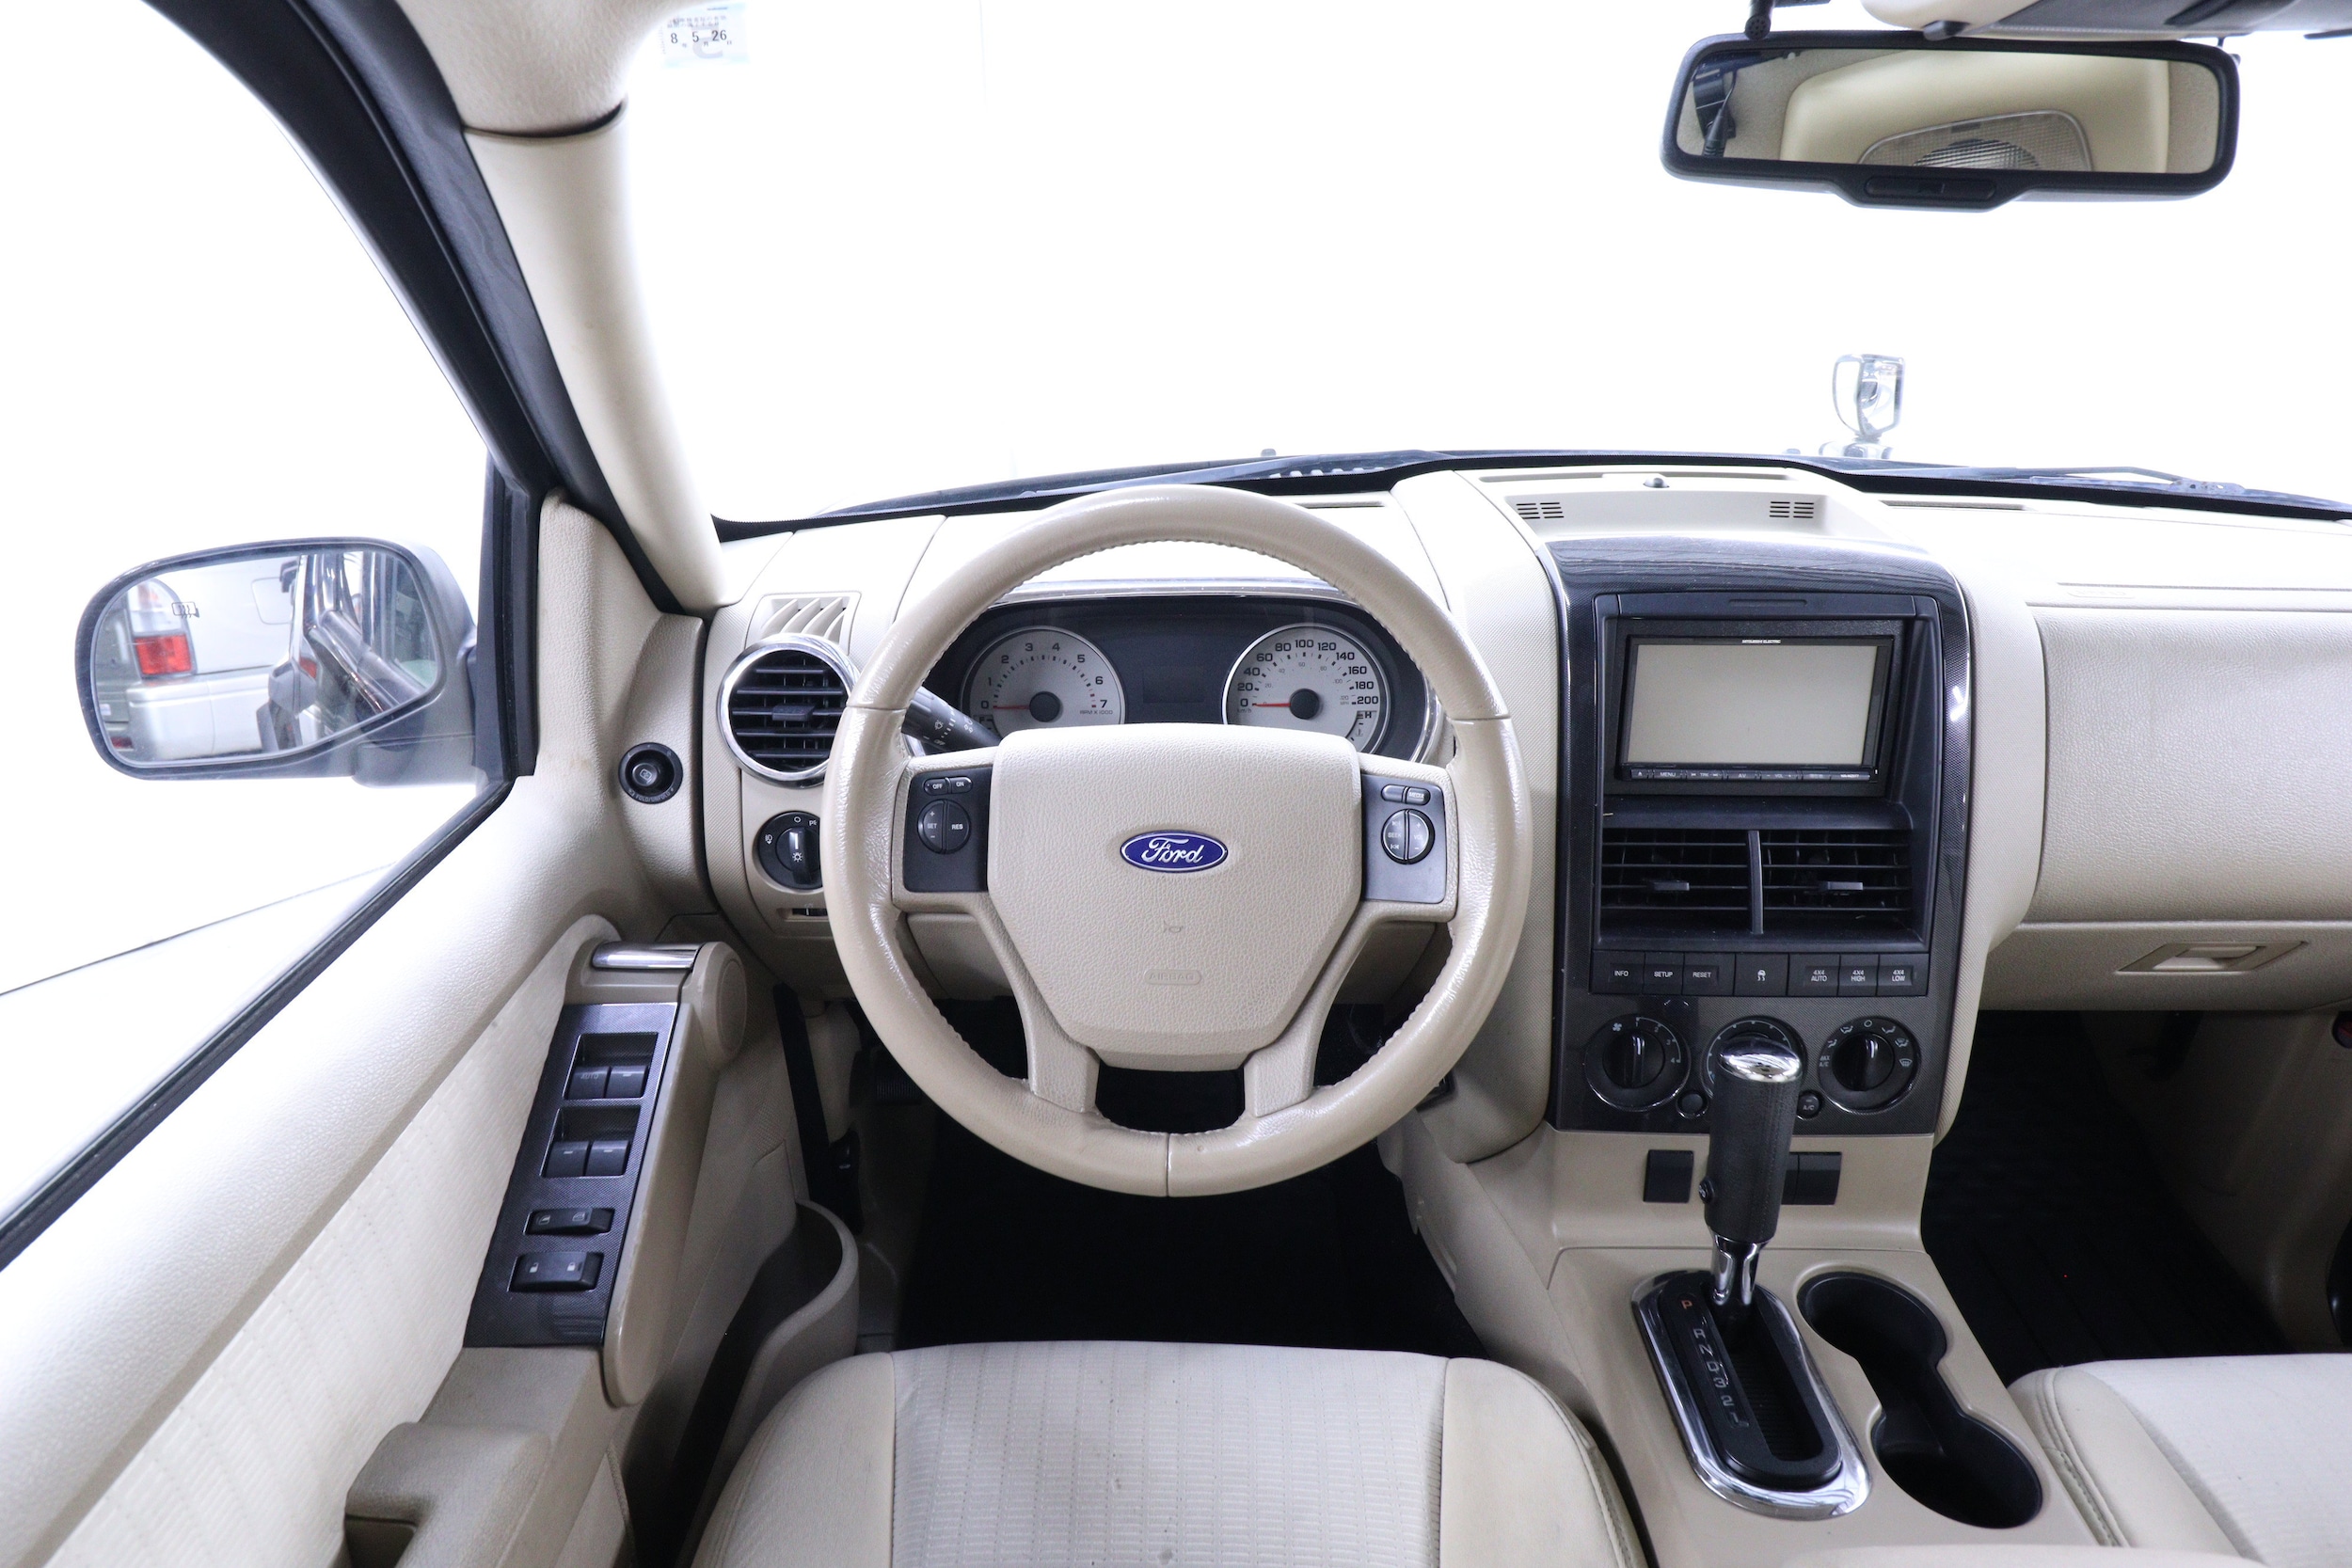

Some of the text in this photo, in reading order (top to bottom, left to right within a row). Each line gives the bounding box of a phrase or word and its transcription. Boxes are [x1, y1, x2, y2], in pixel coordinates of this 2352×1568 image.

[671, 33, 678, 44] 8
[692, 31, 699, 43] 5
[712, 30, 727, 41] 26
[1025, 643, 1033, 651] 3
[1052, 643, 1060, 651] 4
[1275, 643, 1291, 651] 80
[1295, 639, 1314, 648] 100
[1318, 642, 1336, 651] 120
[1001, 655, 1009, 663] 2
[1077, 654, 1085, 663] 5
[1256, 653, 1273, 662] 60
[1336, 652, 1354, 660] 140
[1243, 667, 1260, 676] 40
[1348, 666, 1367, 674] 160
[988, 677, 992, 686] 1
[1095, 676, 1103, 684] 6
[1238, 683, 1253, 691] 20
[1355, 681, 1374, 689] 180
[981, 700, 989, 709] 0
[1100, 700, 1108, 708] 7
[1240, 698, 1248, 707] 0
[1357, 696, 1379, 704] 200
[1141, 837, 1205, 863] Ford
[1681, 1300, 1692, 1309] P
[1693, 1328, 1706, 1339] R
[1699, 1345, 1713, 1356] N
[1713, 1378, 1727, 1388] 3
[1721, 1395, 1734, 1406] 2
